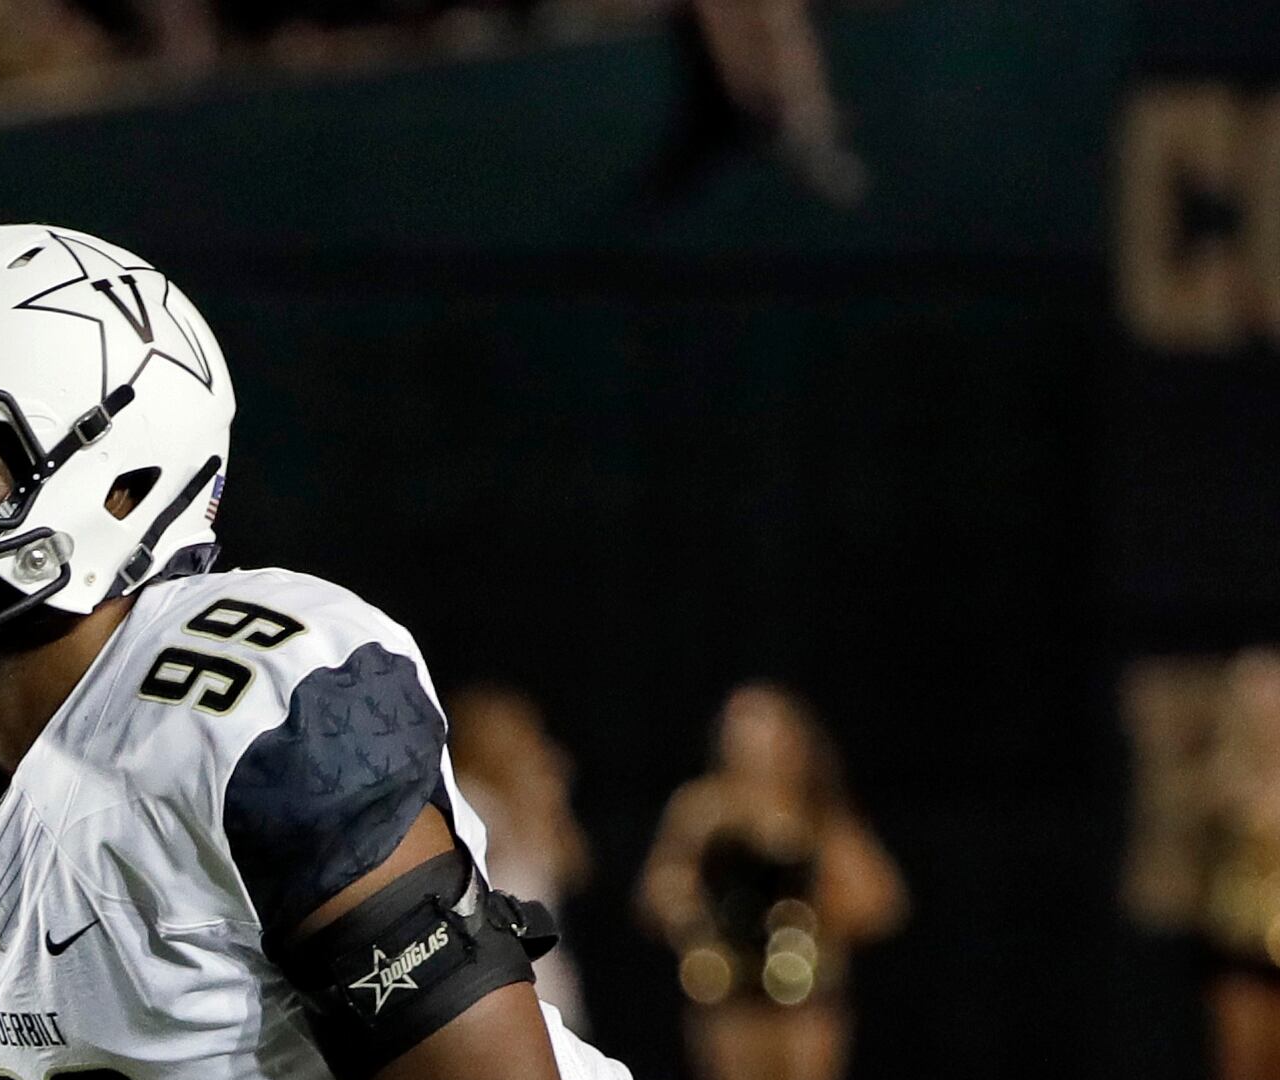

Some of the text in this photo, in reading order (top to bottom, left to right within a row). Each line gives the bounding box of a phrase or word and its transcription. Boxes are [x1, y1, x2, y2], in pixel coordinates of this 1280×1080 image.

[91, 273, 154, 344] V
[138, 597, 310, 717] 99
[380, 926, 449, 988] DOUGLAS
